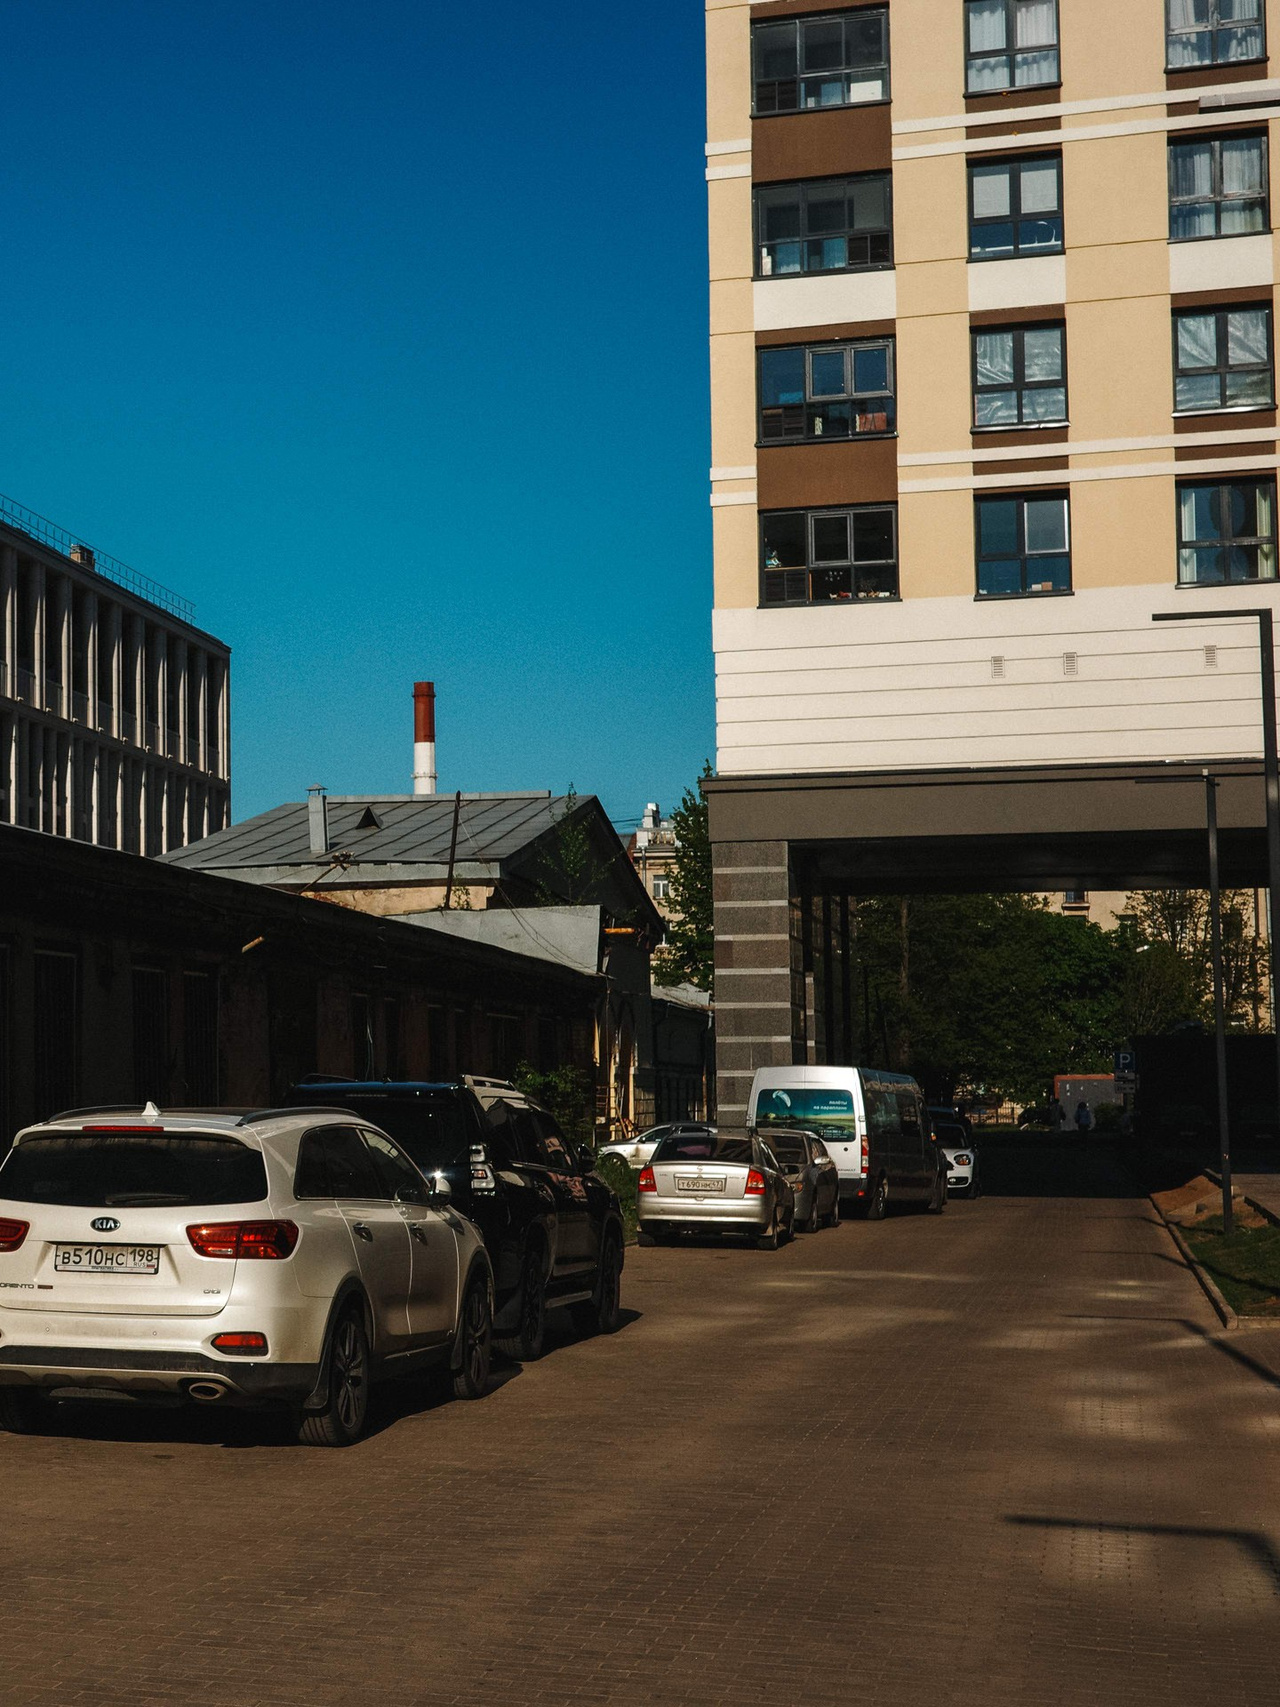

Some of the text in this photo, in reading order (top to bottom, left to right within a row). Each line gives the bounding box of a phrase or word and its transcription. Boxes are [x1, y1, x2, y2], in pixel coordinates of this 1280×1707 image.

[1119, 1053, 1131, 1068] P
[94, 1219, 116, 1229] KIA
[61, 1247, 154, 1266] В510НС 198
